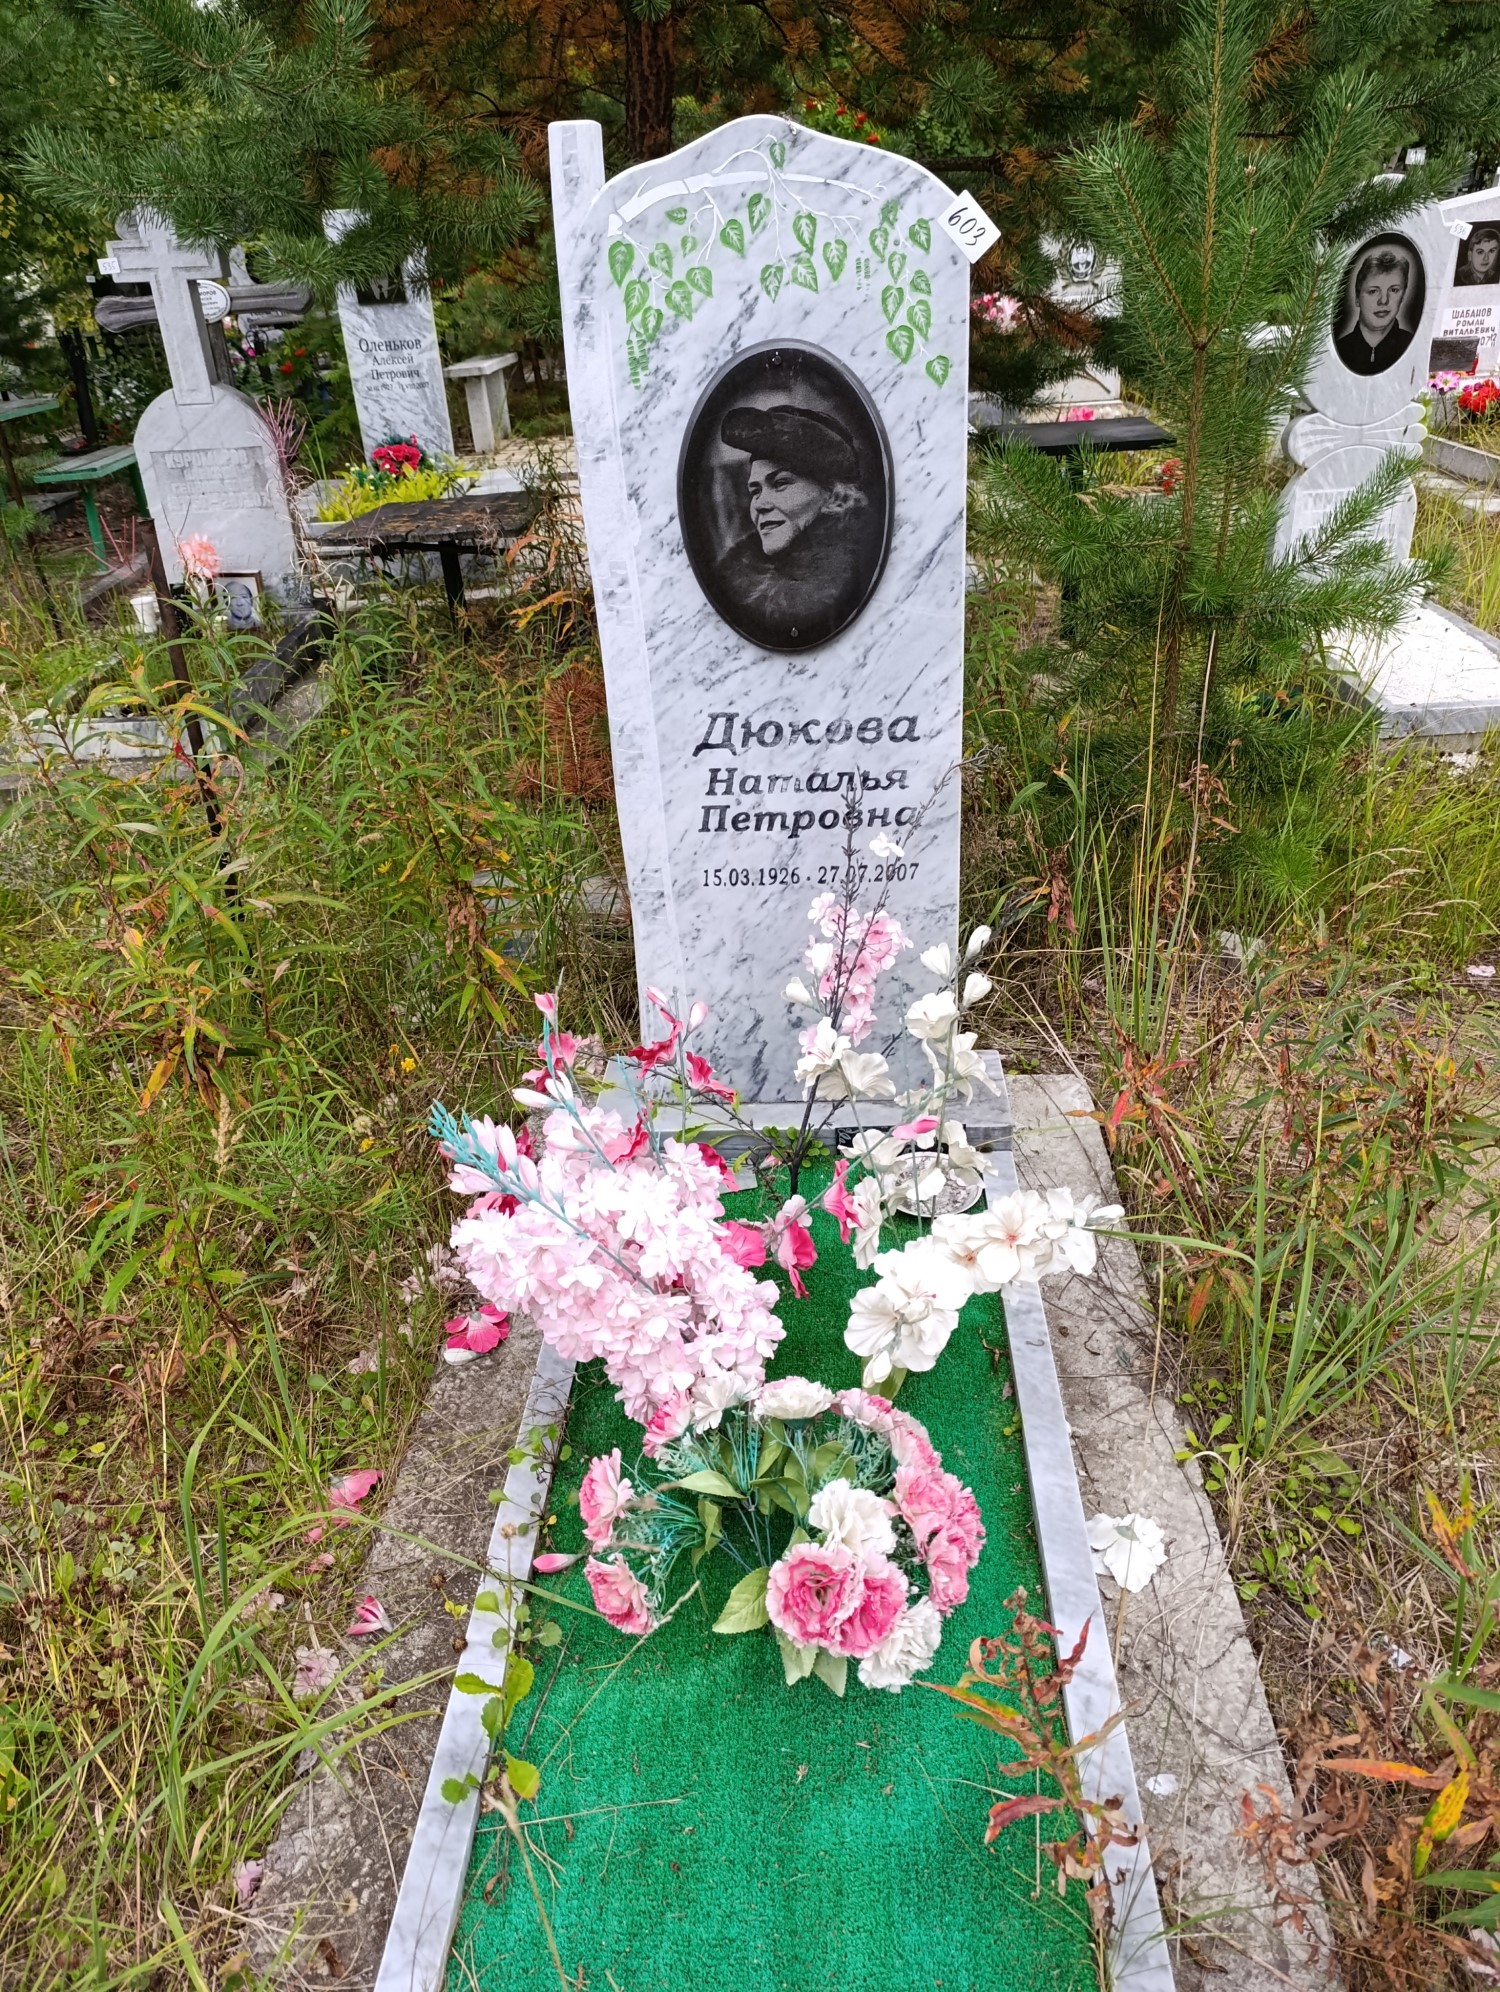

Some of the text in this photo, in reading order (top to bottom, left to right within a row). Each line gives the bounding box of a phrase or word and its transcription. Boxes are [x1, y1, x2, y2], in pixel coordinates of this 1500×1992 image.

[947, 206, 986, 246] 603
[1443, 326, 1496, 337] ВИТАЛЬЕВИЧ
[1456, 319, 1485, 327] РОМАН
[358, 338, 422, 353] Оленьков
[372, 353, 415, 367] Алексей
[370, 368, 420, 382] Петрович
[692, 712, 921, 758] Дюкова
[705, 767, 910, 797] Наталья
[698, 804, 920, 839] Петровна
[702, 866, 801, 887] 15.03.1926
